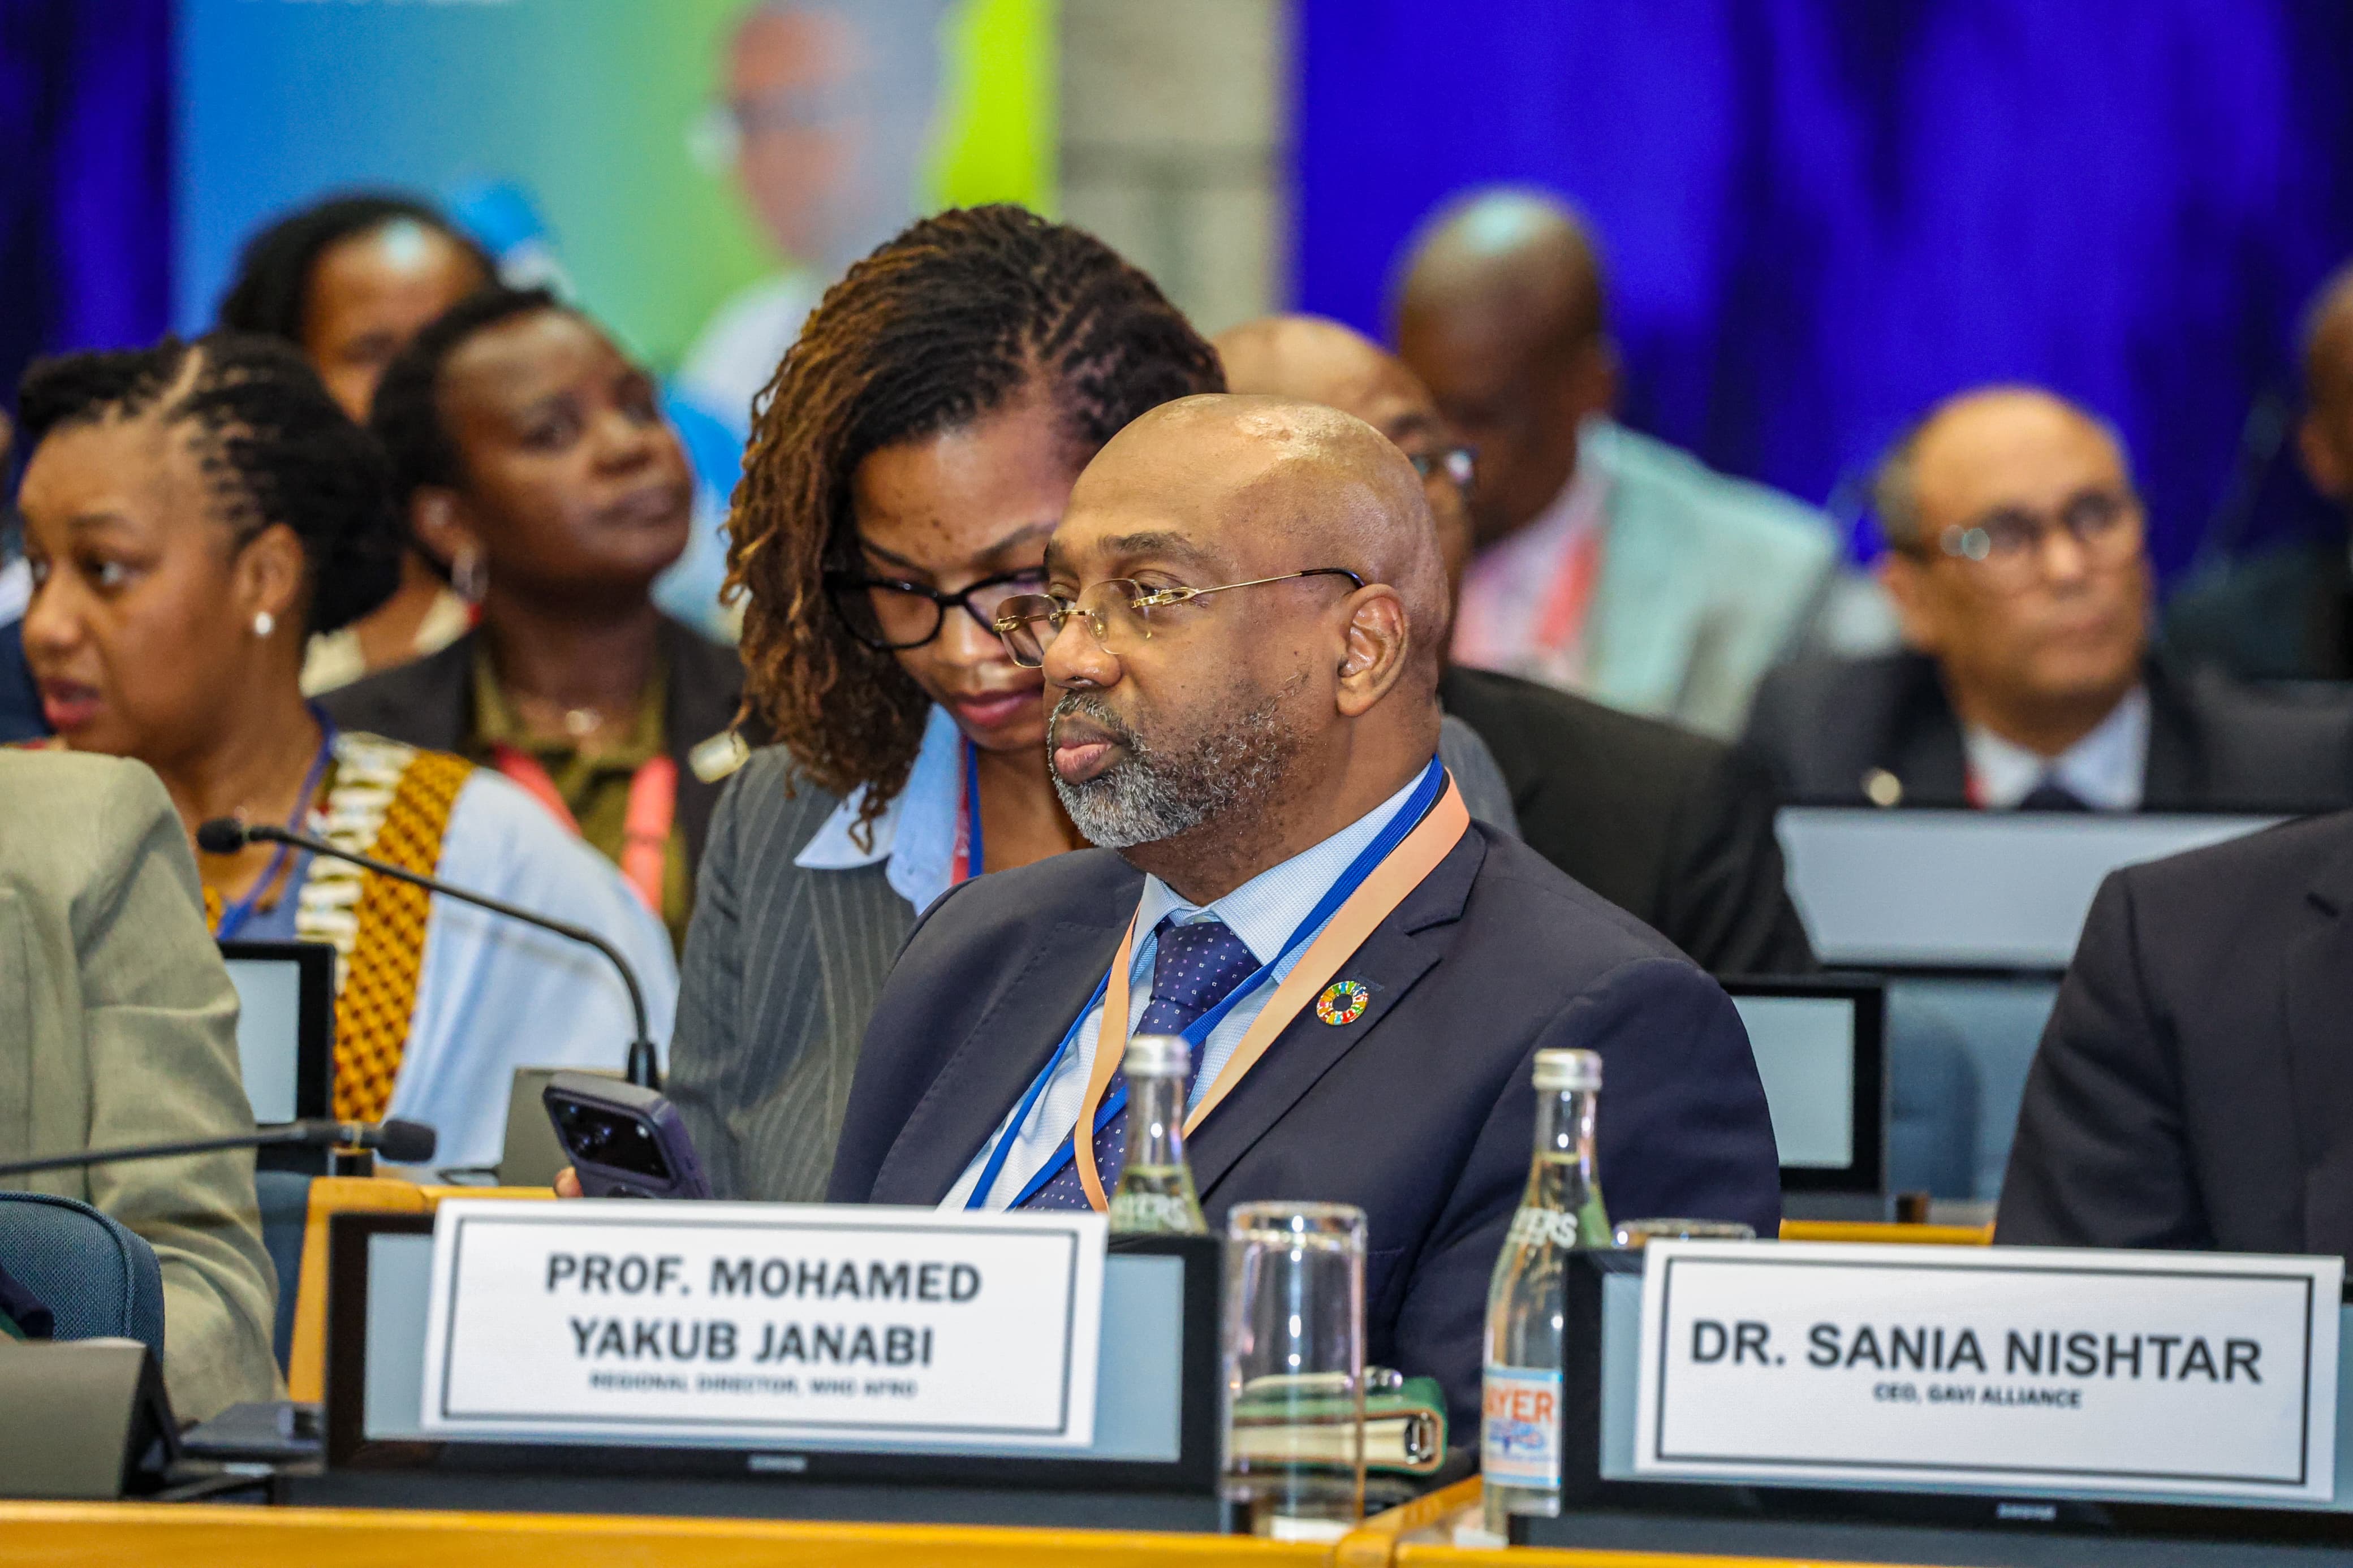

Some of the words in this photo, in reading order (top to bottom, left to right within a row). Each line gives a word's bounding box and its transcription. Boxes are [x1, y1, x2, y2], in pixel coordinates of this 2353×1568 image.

[545, 1253, 690, 1296] PROF.
[709, 1256, 982, 1303] MOHAMED
[569, 1317, 739, 1363] YAKUB
[754, 1322, 934, 1367] JANABI
[1691, 1319, 1786, 1367] DR.
[1807, 1323, 1988, 1374] SANIA
[2005, 1329, 2263, 1384] NISHTAR
[588, 1370, 688, 1392] REGIONAL
[809, 1378, 855, 1396] WHO
[863, 1379, 918, 1398] AFRO
[1926, 1384, 1976, 1405] GAVI
[1980, 1386, 2083, 1409] ALLIANCE
